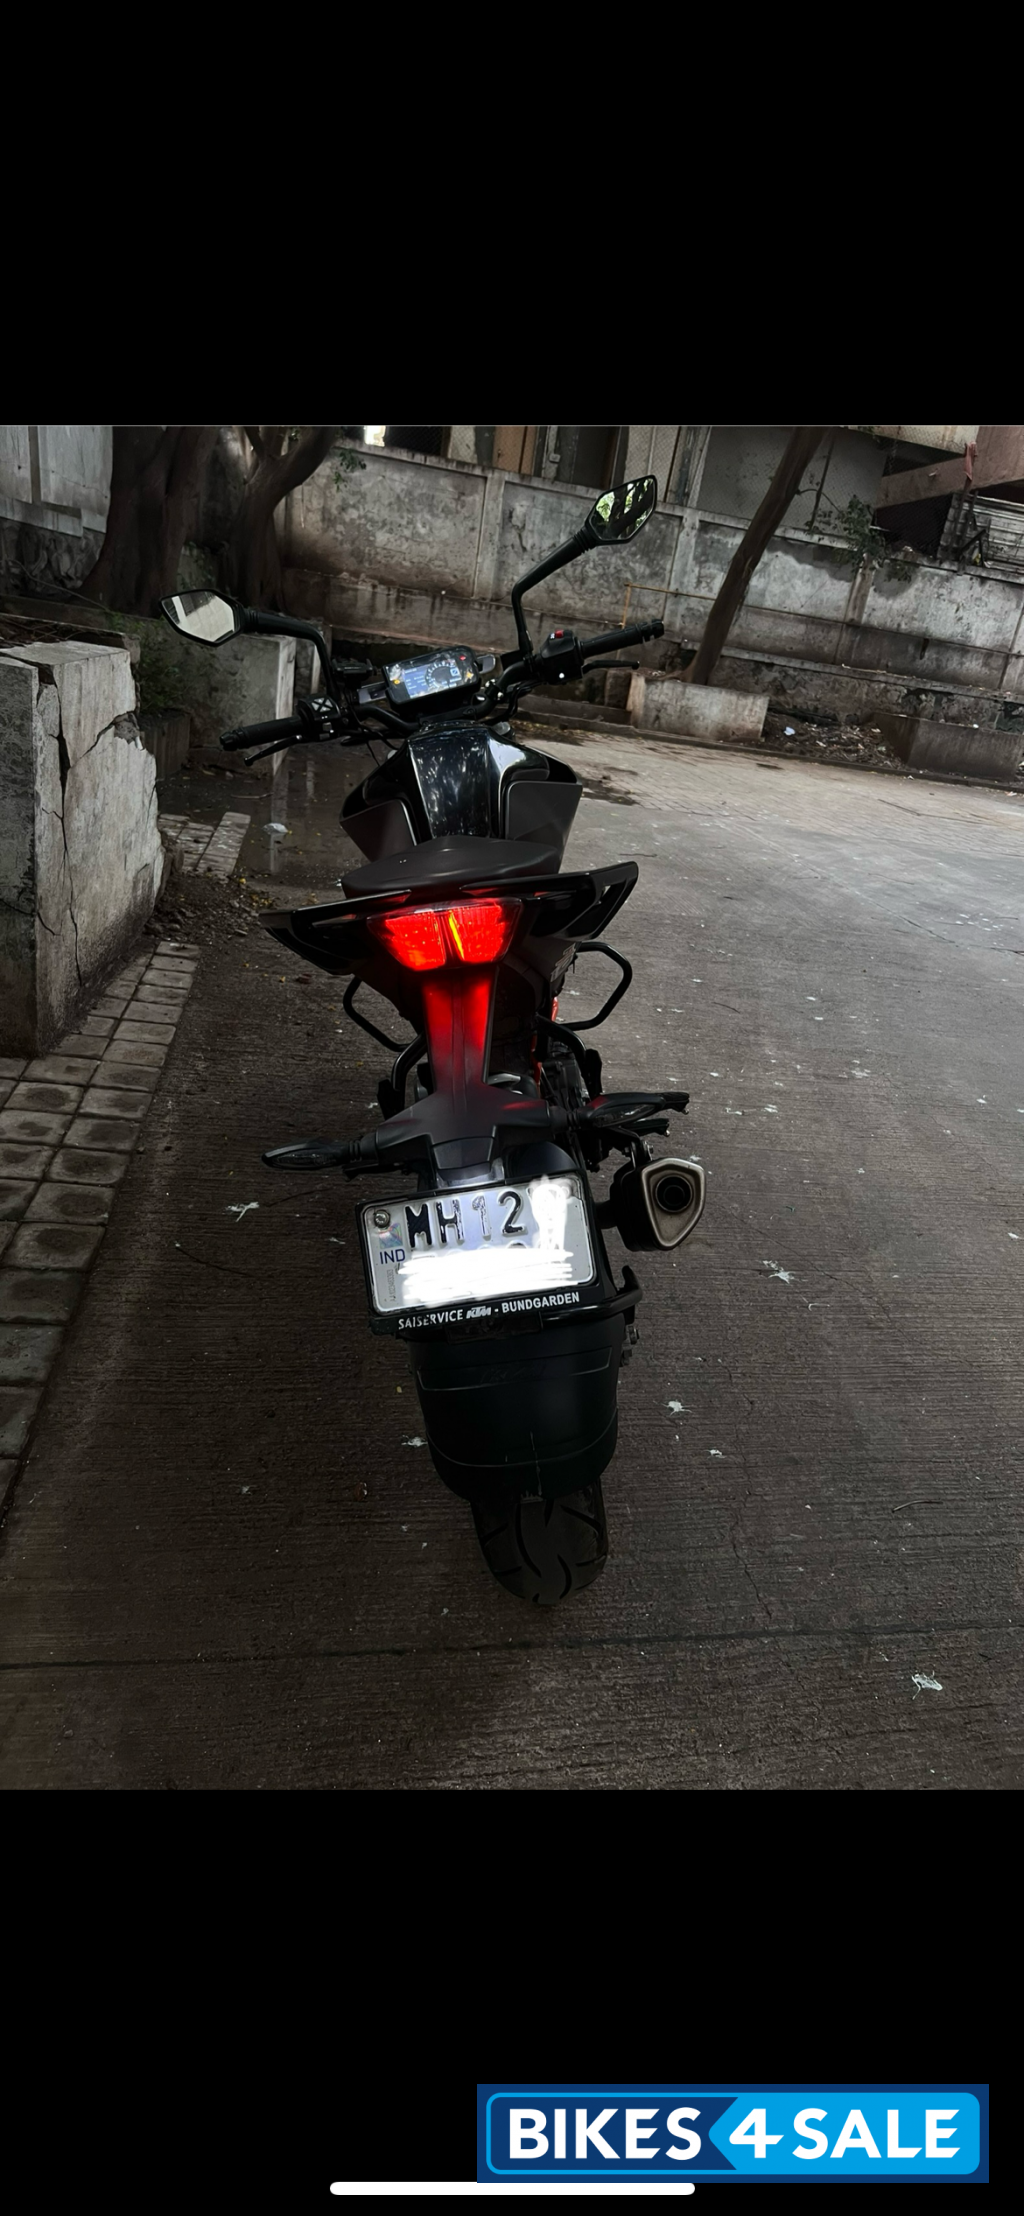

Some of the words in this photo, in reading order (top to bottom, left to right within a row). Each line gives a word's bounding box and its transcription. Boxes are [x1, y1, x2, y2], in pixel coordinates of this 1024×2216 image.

[379, 1248, 406, 1265] IND
[398, 1309, 463, 1330] SAISERVICE
[466, 1305, 492, 1319] KTM
[501, 1291, 580, 1314] BUNDGARDEN
